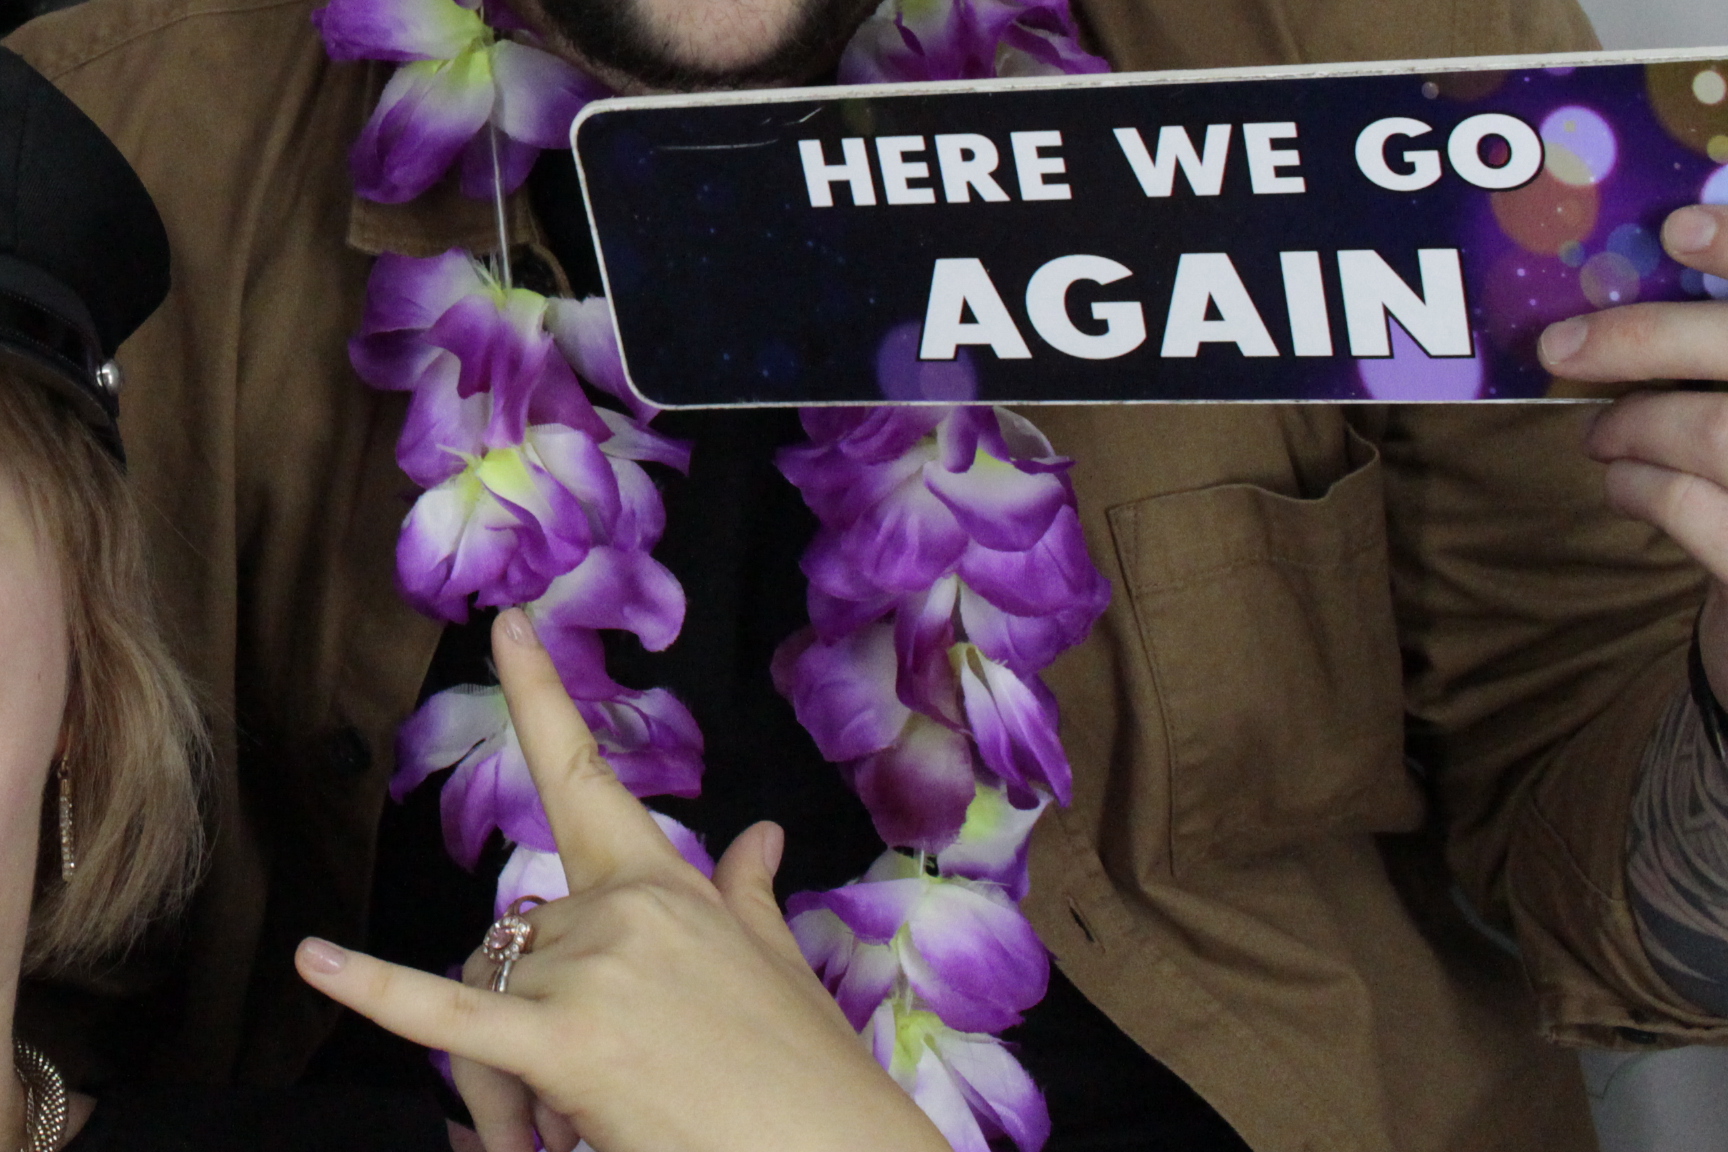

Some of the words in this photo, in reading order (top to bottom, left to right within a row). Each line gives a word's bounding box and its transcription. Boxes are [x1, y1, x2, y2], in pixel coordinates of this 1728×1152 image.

[797, 129, 1073, 208] HERE
[1113, 120, 1307, 198] WE
[1354, 112, 1543, 192] GO
[919, 247, 1473, 361] AGAIN
